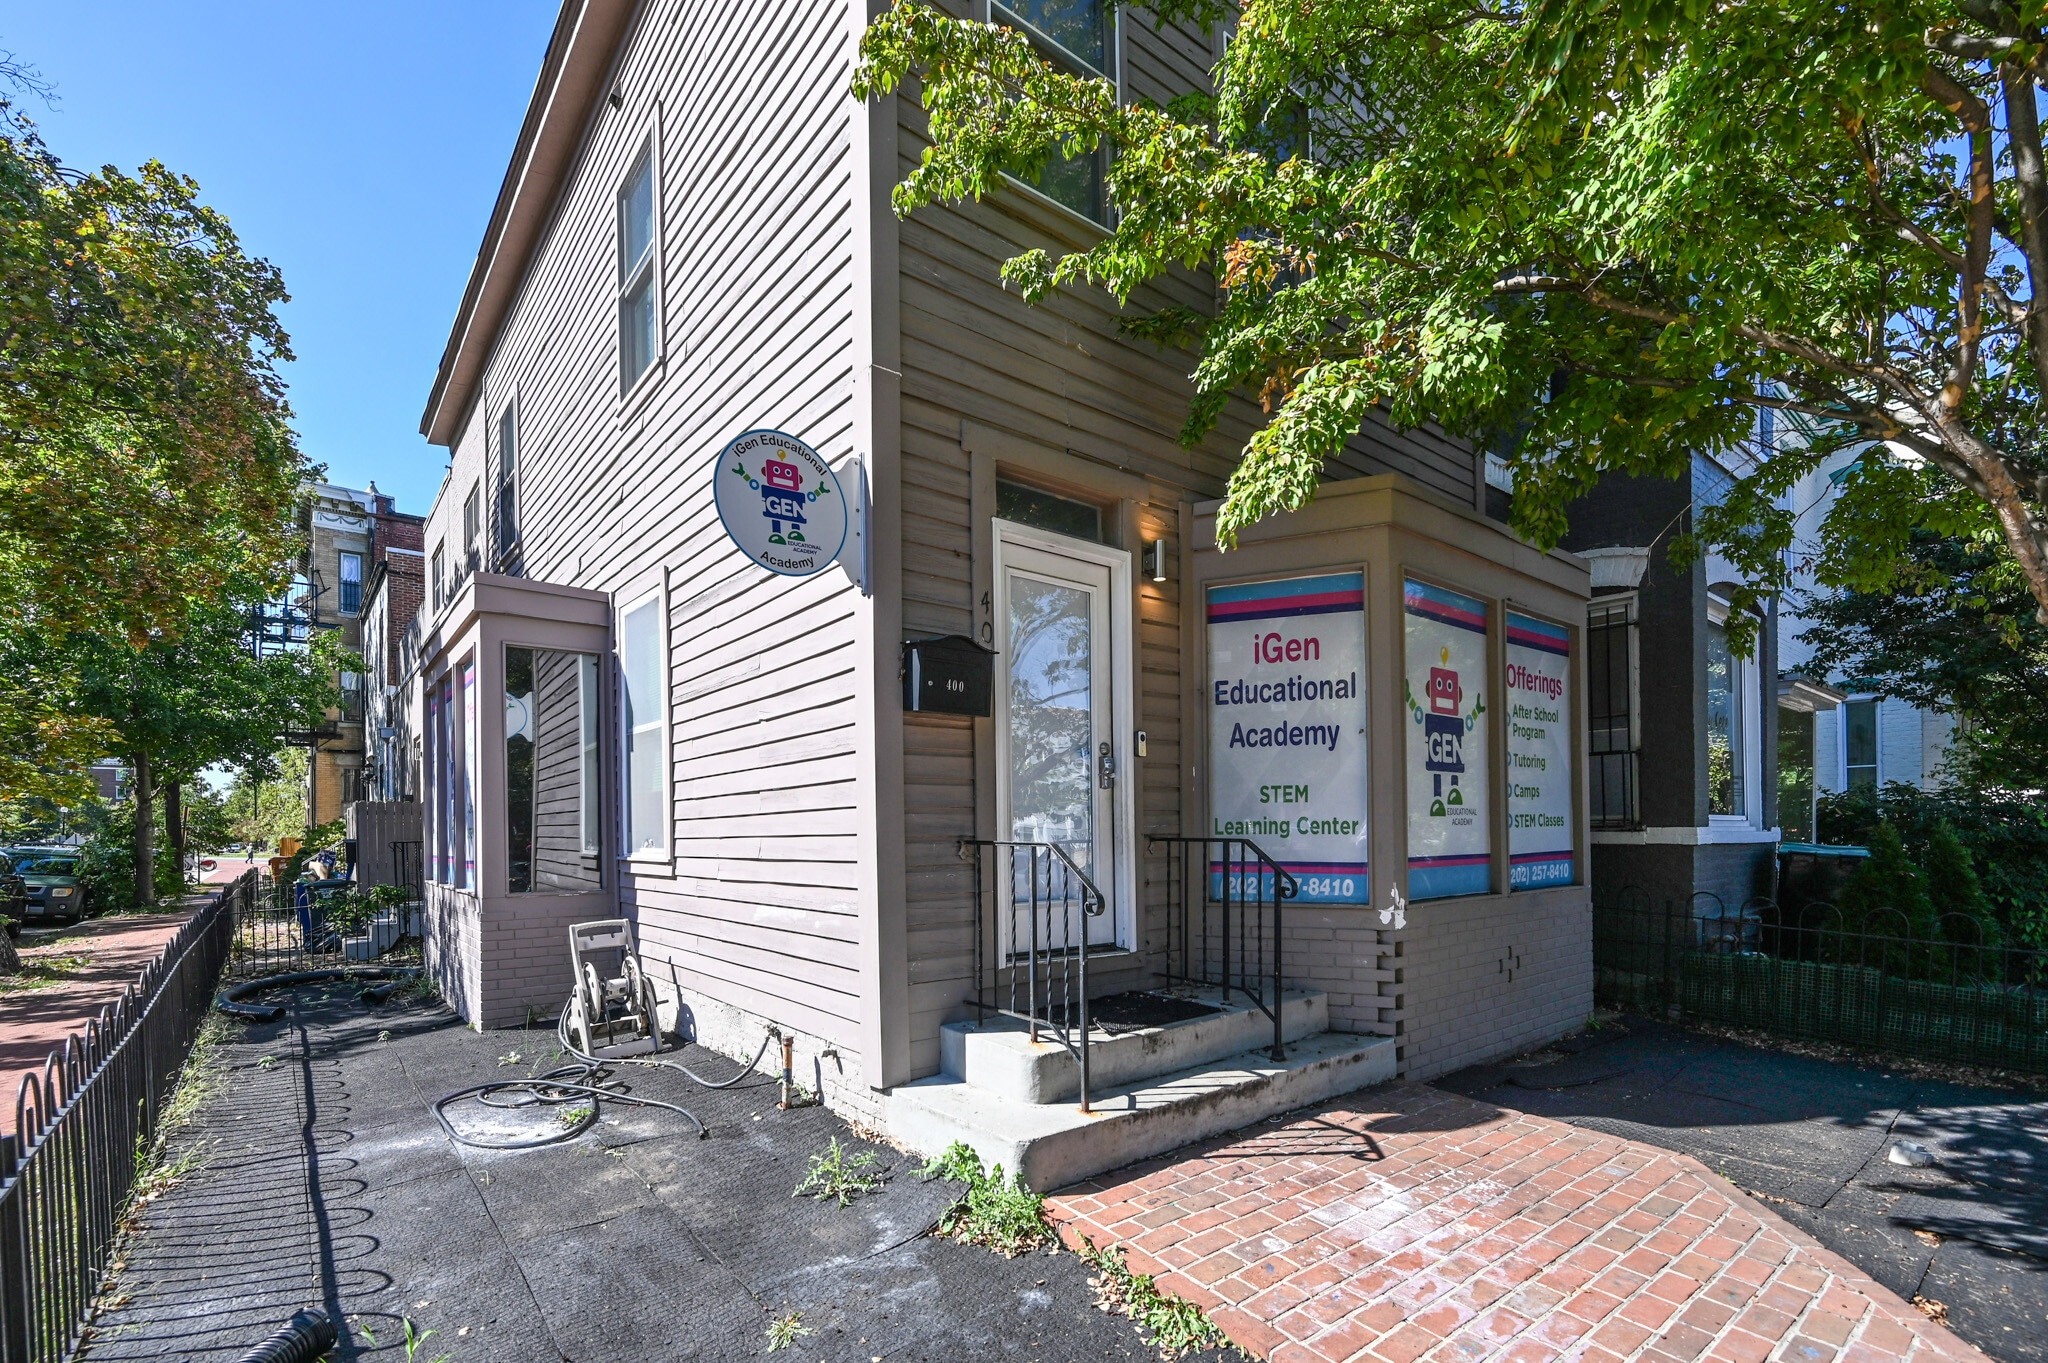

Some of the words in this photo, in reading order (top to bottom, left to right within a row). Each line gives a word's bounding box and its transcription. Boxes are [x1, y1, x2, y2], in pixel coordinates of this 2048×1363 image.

[731, 438, 759, 458] iGen
[760, 434, 828, 476] Educational
[787, 540, 822, 551] EDUCATIONAL
[792, 547, 818, 556] ACADEMY
[760, 550, 815, 569] Academy
[1254, 632, 1320, 665] iGen
[946, 679, 964, 692] 400
[1214, 671, 1356, 706] Educational
[1506, 663, 1563, 701] Offerings
[1512, 703, 1533, 720] After
[1534, 706, 1559, 723] School
[1229, 720, 1341, 752] Academy
[1512, 722, 1546, 741] Program
[1513, 753, 1546, 771] Tutoring
[1259, 784, 1309, 804] STEM
[1514, 783, 1540, 800] Camps
[1446, 807, 1477, 817] EDUCATIONAL
[1451, 816, 1473, 826] ACADEMY
[1514, 813, 1536, 828] STEM
[1537, 812, 1564, 827] Classes
[1214, 816, 1291, 838] Learning
[1296, 816, 1359, 835] Center
[1532, 863, 1569, 881] 257-8410
